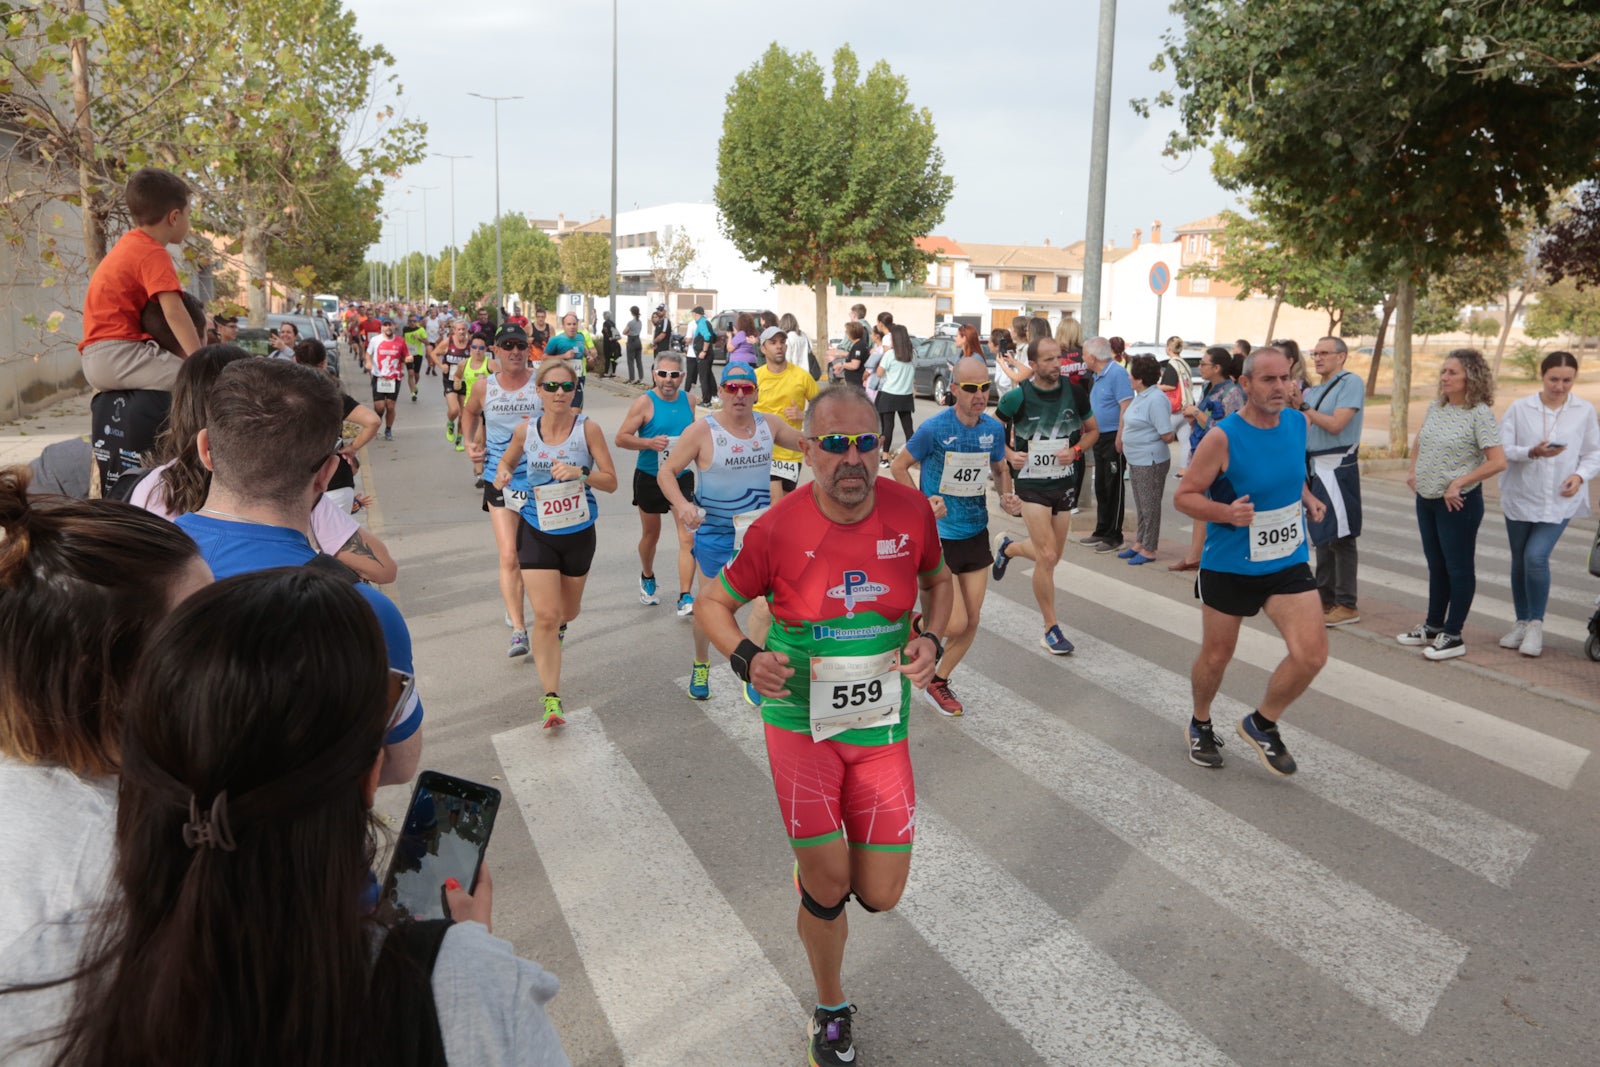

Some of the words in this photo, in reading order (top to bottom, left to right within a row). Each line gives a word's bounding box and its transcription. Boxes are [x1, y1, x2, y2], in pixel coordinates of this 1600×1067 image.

[492, 403, 535, 412] MARACENA
[772, 459, 795, 473] 3044
[954, 468, 981, 482] 487
[543, 495, 581, 515] 2097
[1258, 522, 1298, 546] 3095
[831, 679, 883, 710] 559
